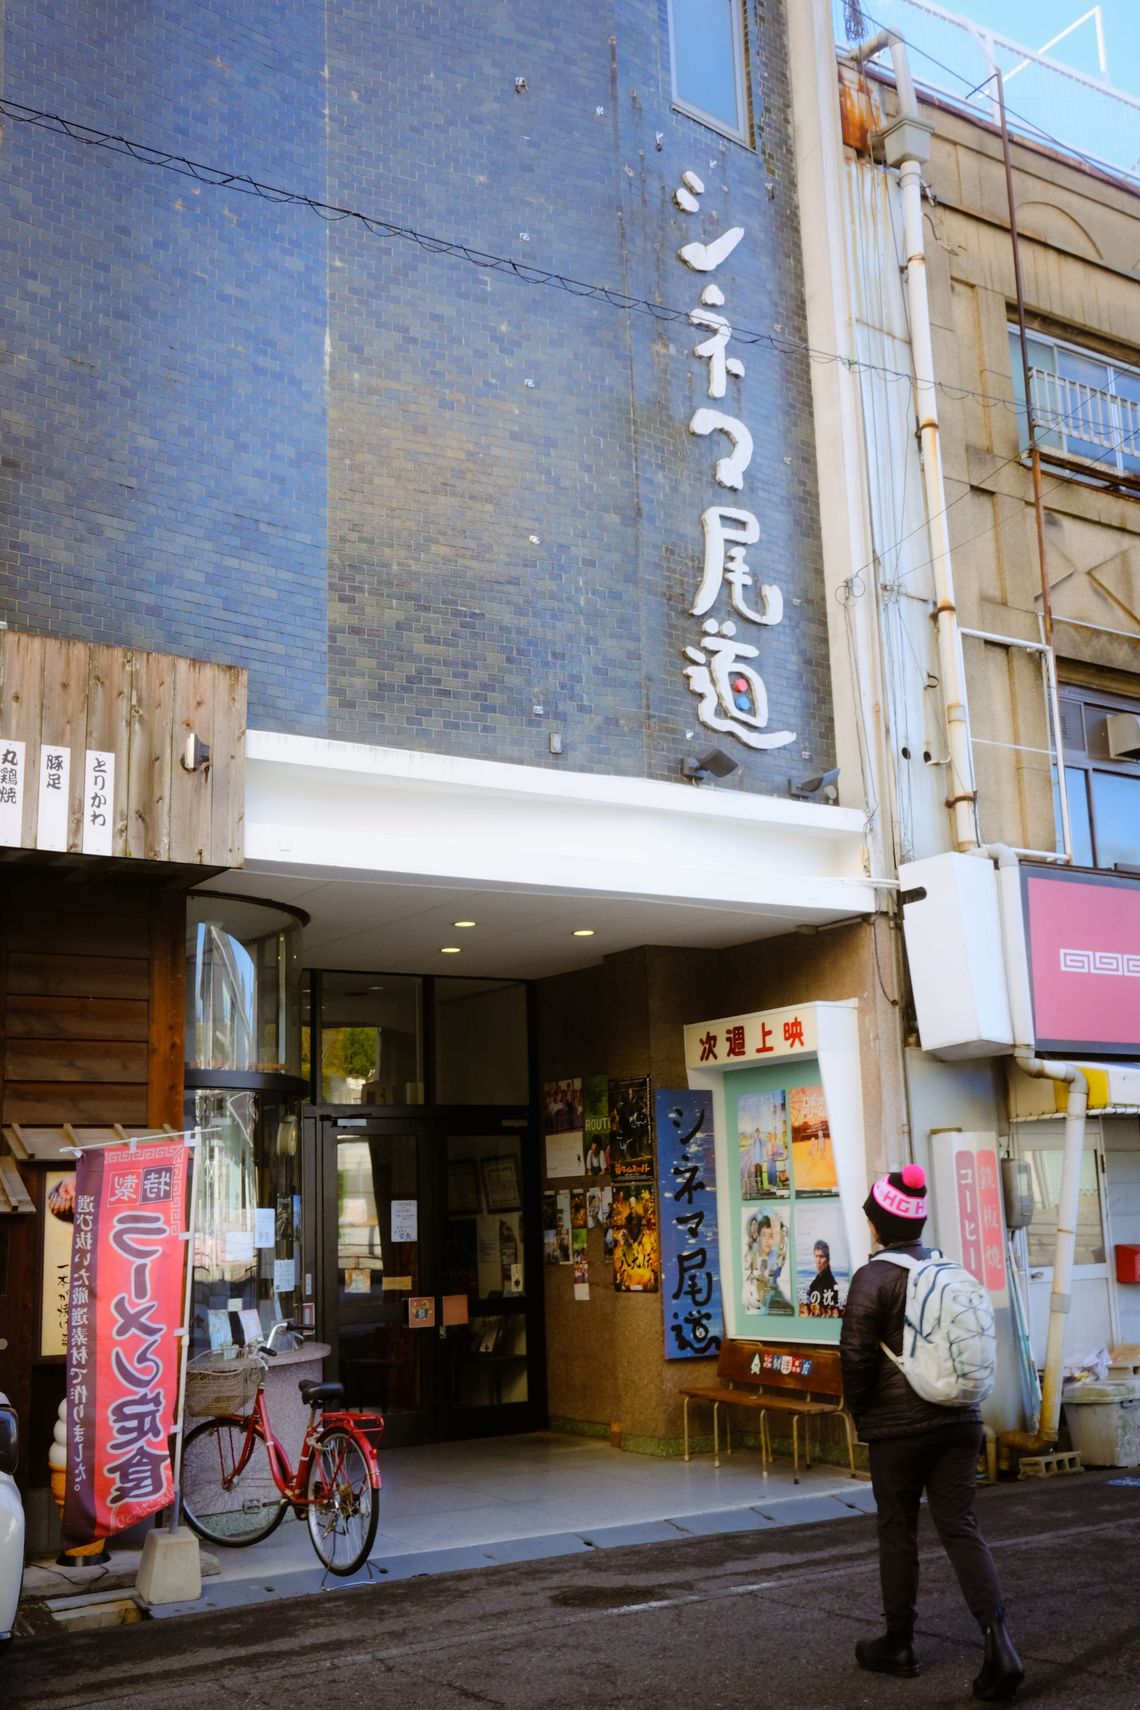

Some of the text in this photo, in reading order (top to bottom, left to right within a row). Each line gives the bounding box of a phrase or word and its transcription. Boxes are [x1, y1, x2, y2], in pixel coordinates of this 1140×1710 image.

[672, 169, 798, 751] シネマ尾道
[46, 754, 63, 790] 豚足
[90, 757, 107, 827] とりかわ
[699, 1016, 804, 1062] 次週上映
[671, 1108, 722, 1354] シネマ尾道
[959, 1168, 977, 1271] コーヒー
